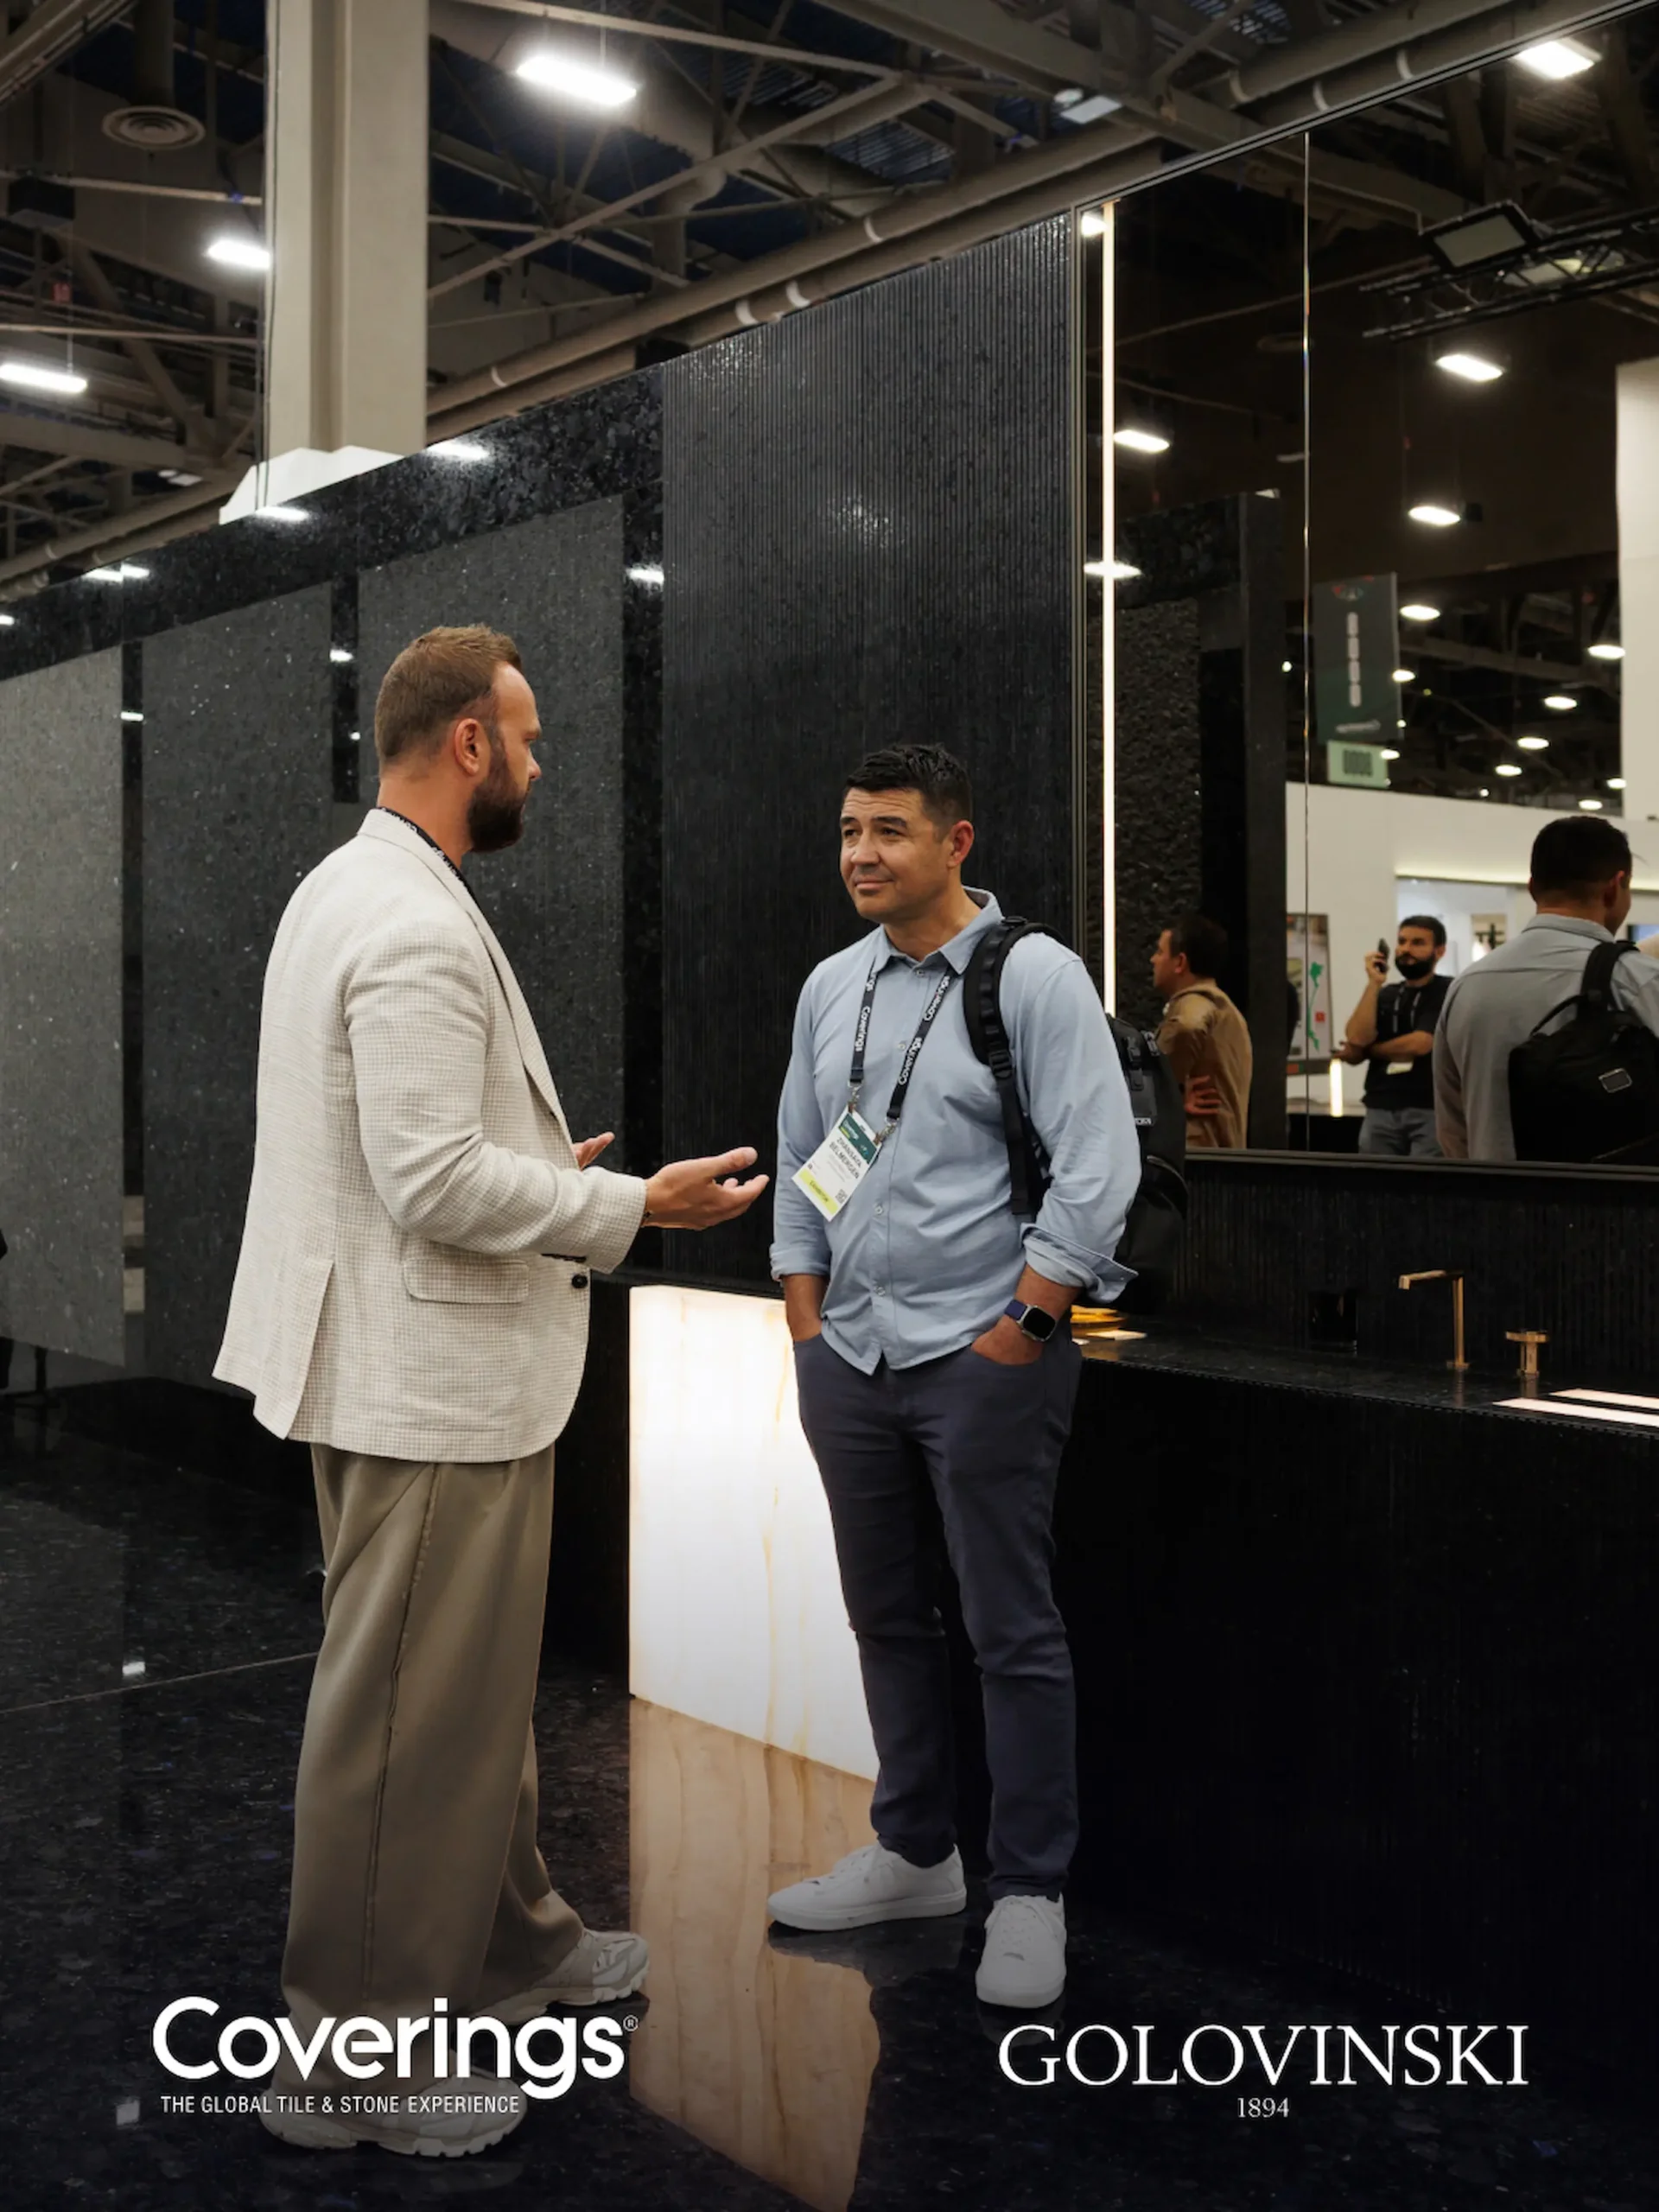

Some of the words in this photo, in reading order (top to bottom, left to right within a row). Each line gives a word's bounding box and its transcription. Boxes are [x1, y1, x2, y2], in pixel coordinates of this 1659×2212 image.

[925, 976, 950, 1021] Coverings
[855, 1006, 871, 1052] Coverings
[899, 1037, 922, 1085] Coverings
